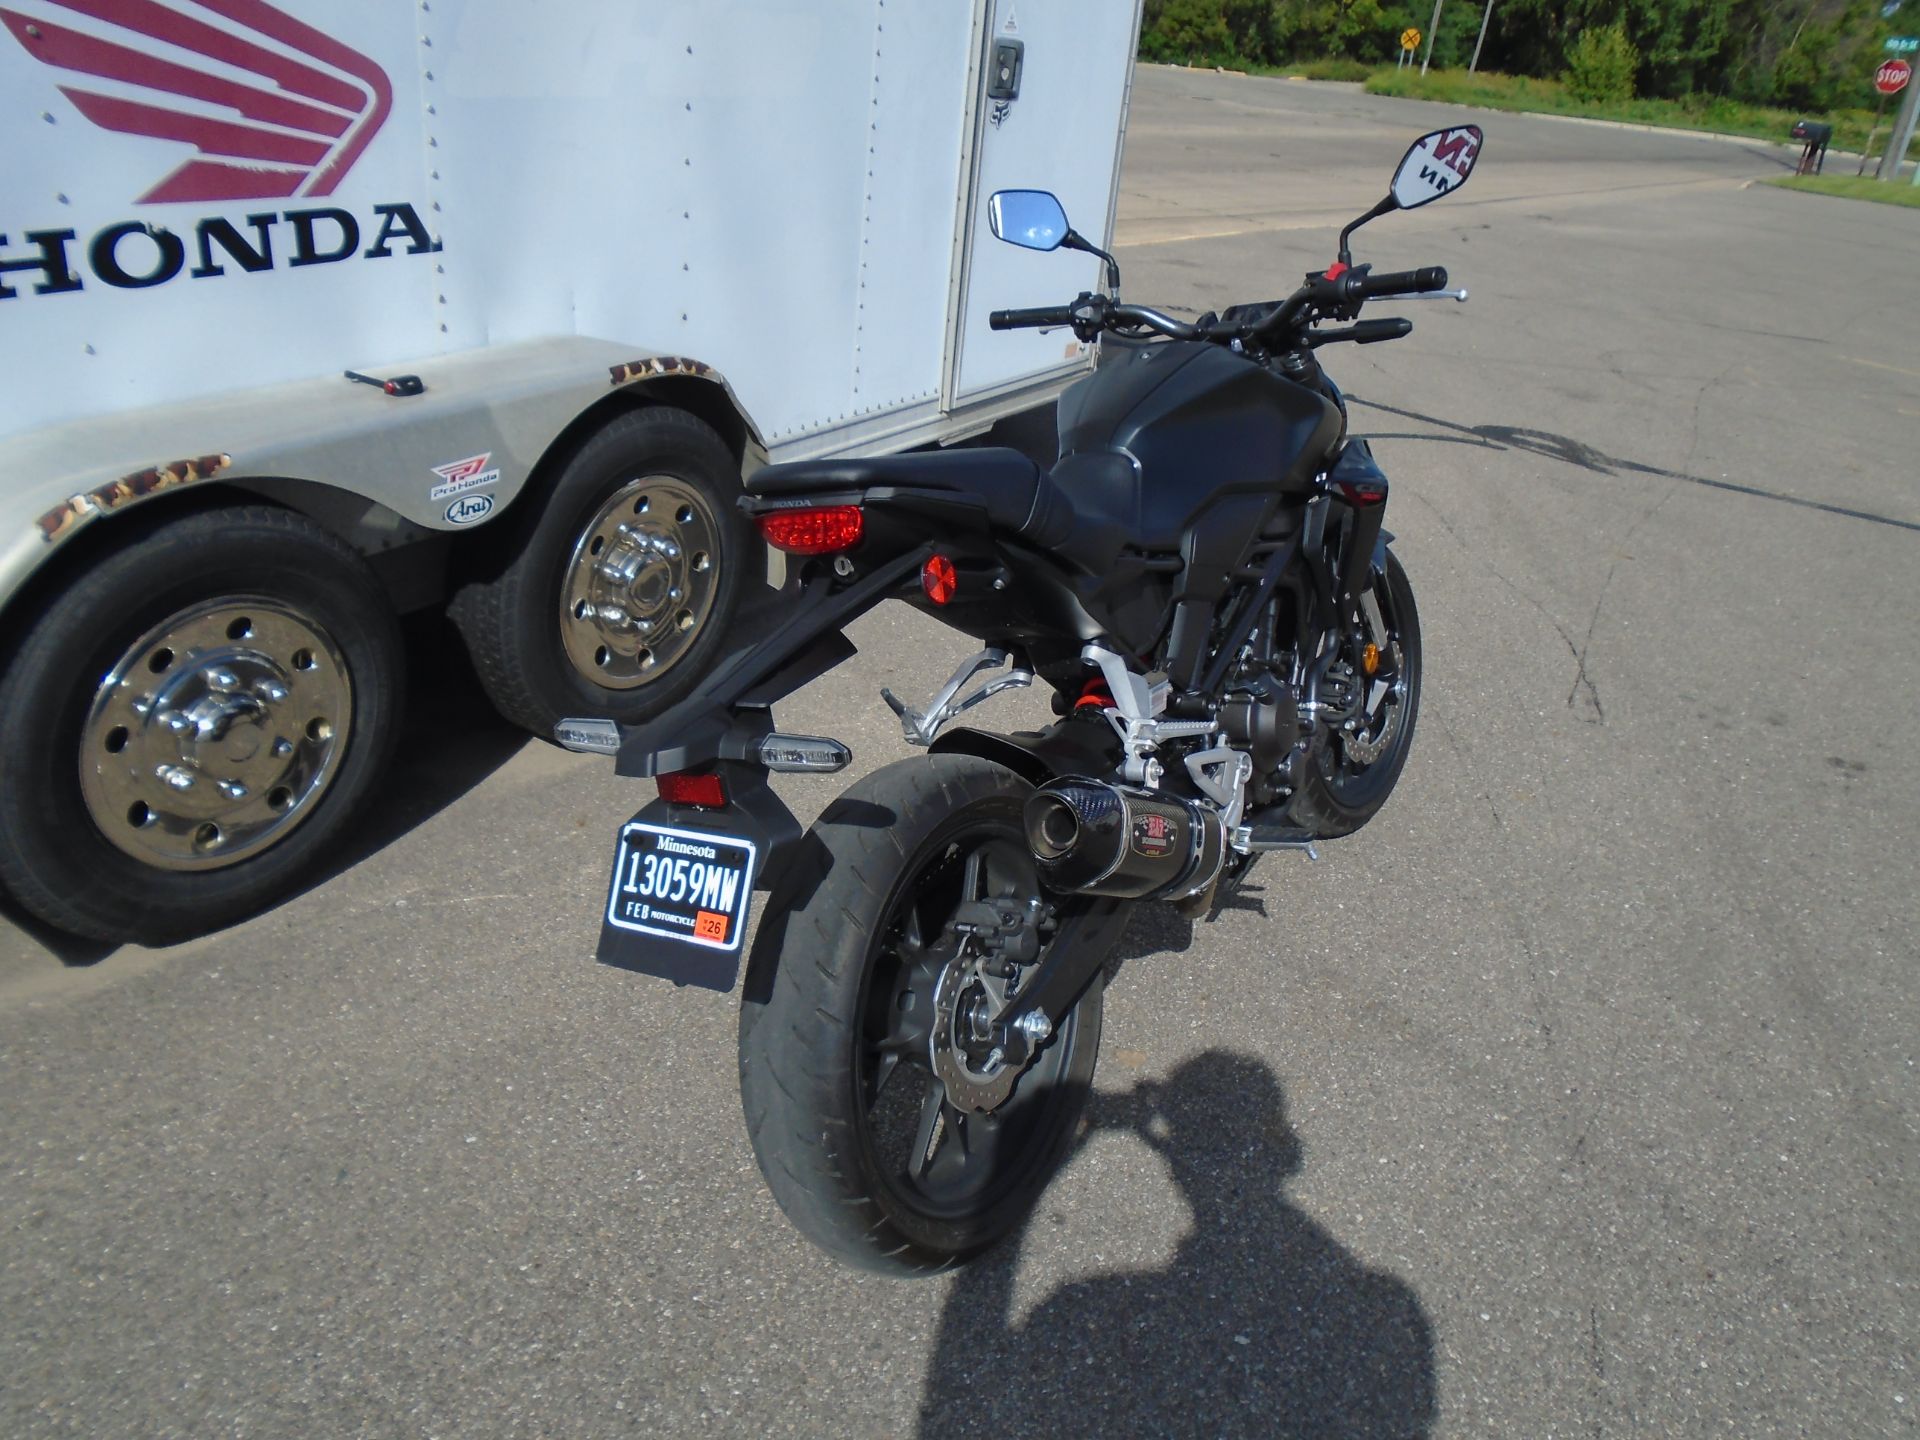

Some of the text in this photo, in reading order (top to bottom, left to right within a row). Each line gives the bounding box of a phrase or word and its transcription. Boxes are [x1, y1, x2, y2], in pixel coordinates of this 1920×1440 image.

[1877, 68, 1908, 84] STOP
[0, 202, 443, 299] HONDA
[433, 473, 497, 497] Pro Honda
[772, 499, 812, 508] HONDA
[657, 836, 716, 858] Minnesota
[623, 851, 740, 913] 13059MW
[626, 901, 651, 920] FEB
[650, 910, 696, 927] MOTORCYCLE
[707, 920, 721, 935] 26
